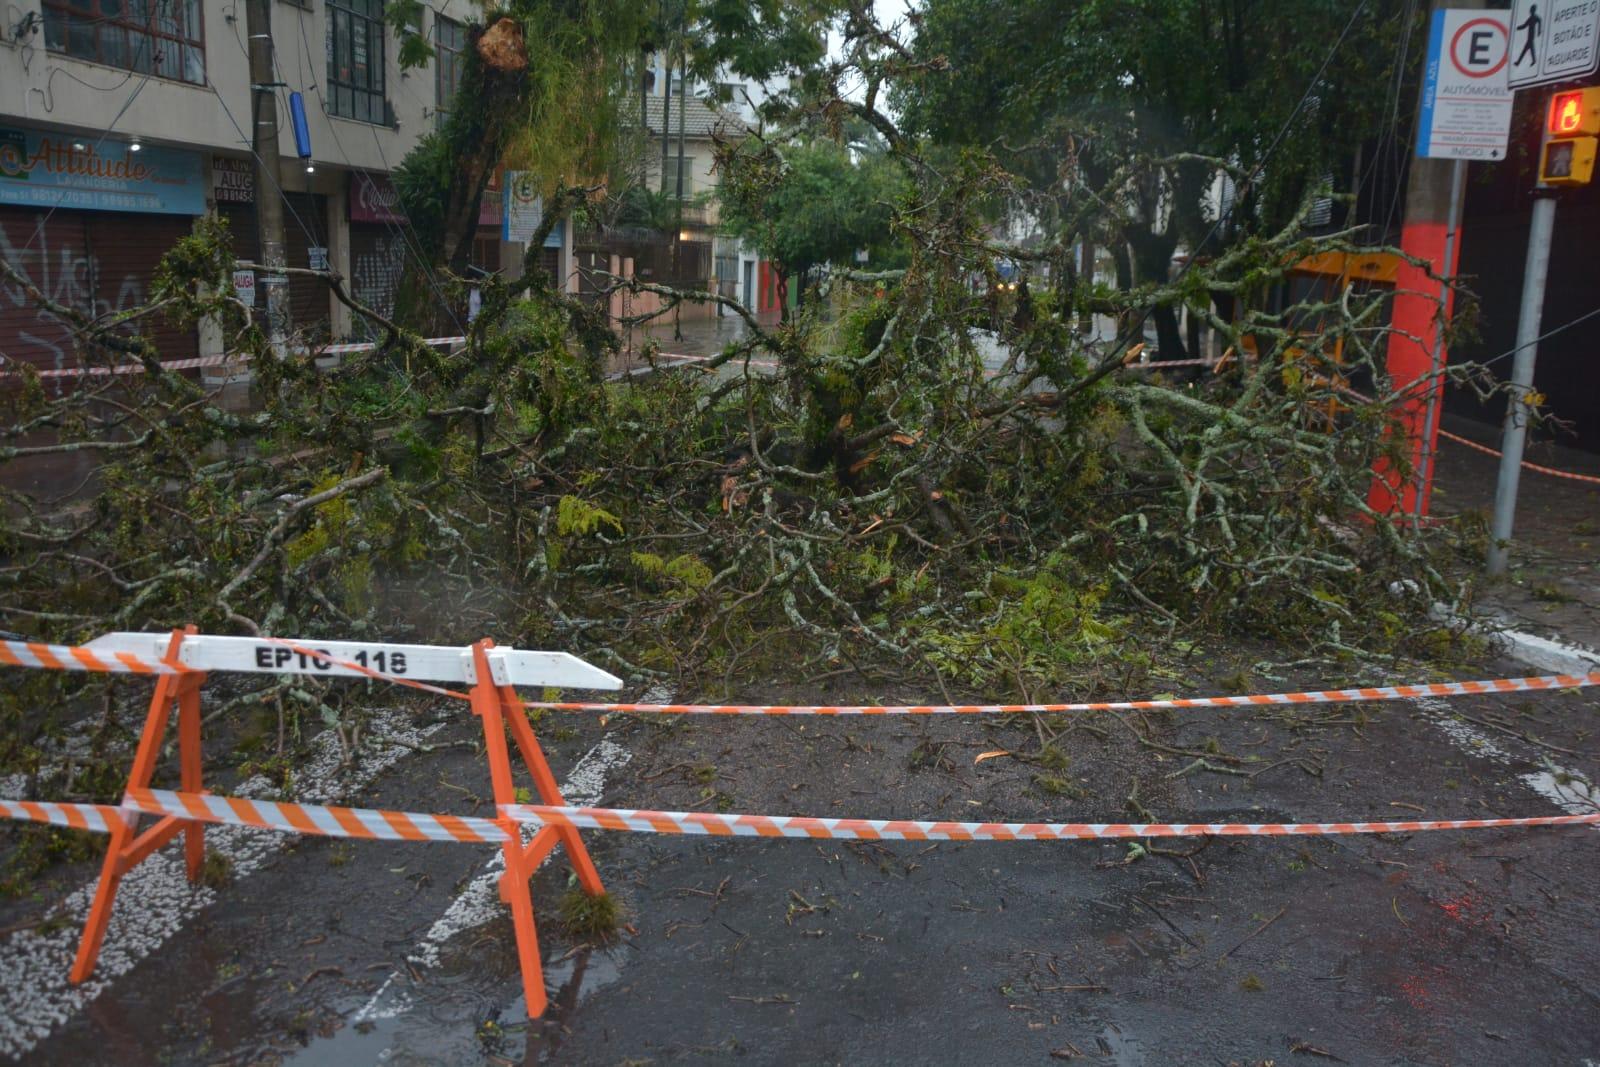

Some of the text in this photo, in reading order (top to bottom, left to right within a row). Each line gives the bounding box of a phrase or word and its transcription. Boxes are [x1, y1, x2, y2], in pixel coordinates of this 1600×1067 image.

[1554, 1, 1598, 23] APERTE O
[1553, 23, 1593, 46] BOTÃO E
[1468, 31, 1494, 65] E
[1547, 46, 1591, 66] AGUARDE
[355, 651, 407, 675] 118
